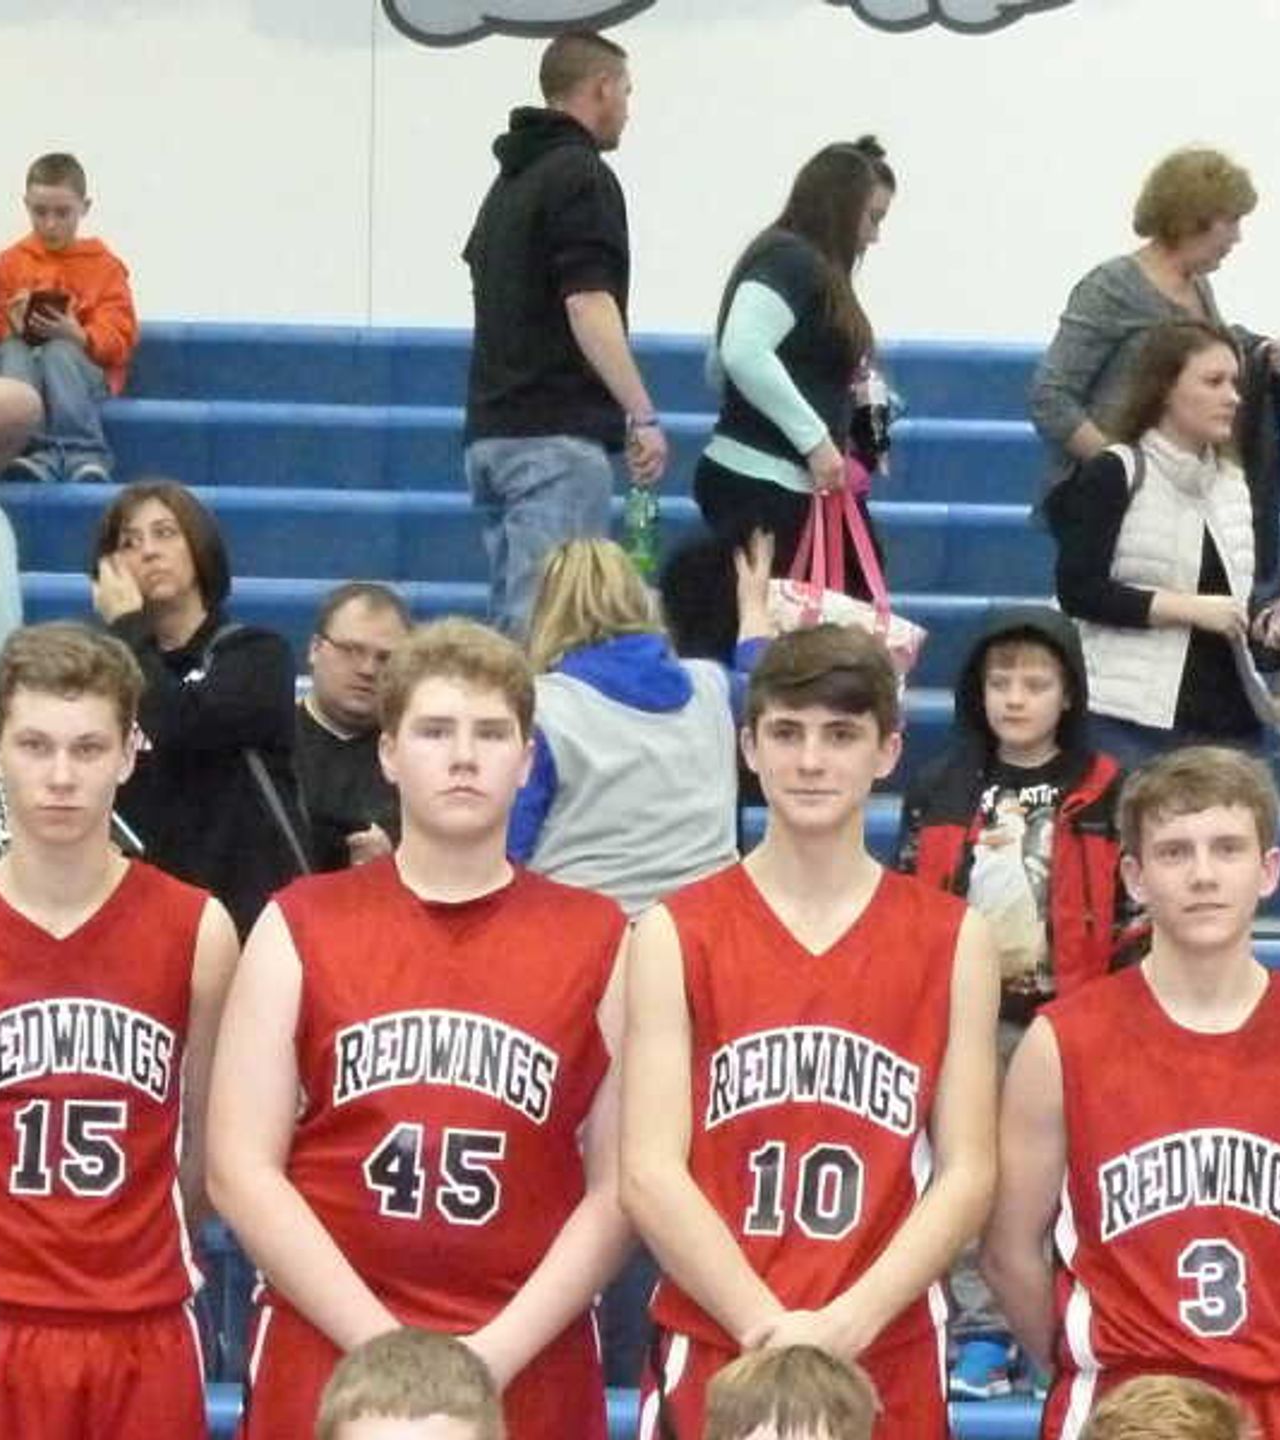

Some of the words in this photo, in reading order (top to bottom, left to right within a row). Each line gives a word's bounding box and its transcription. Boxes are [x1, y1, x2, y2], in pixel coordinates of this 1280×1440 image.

[332, 1008, 559, 1125] REDWINGS
[704, 1025, 920, 1137] REDWINGS
[9, 1098, 127, 1197] 15
[362, 1122, 506, 1226] 45
[744, 1140, 864, 1240] 10
[1177, 1238, 1248, 1338] 3
